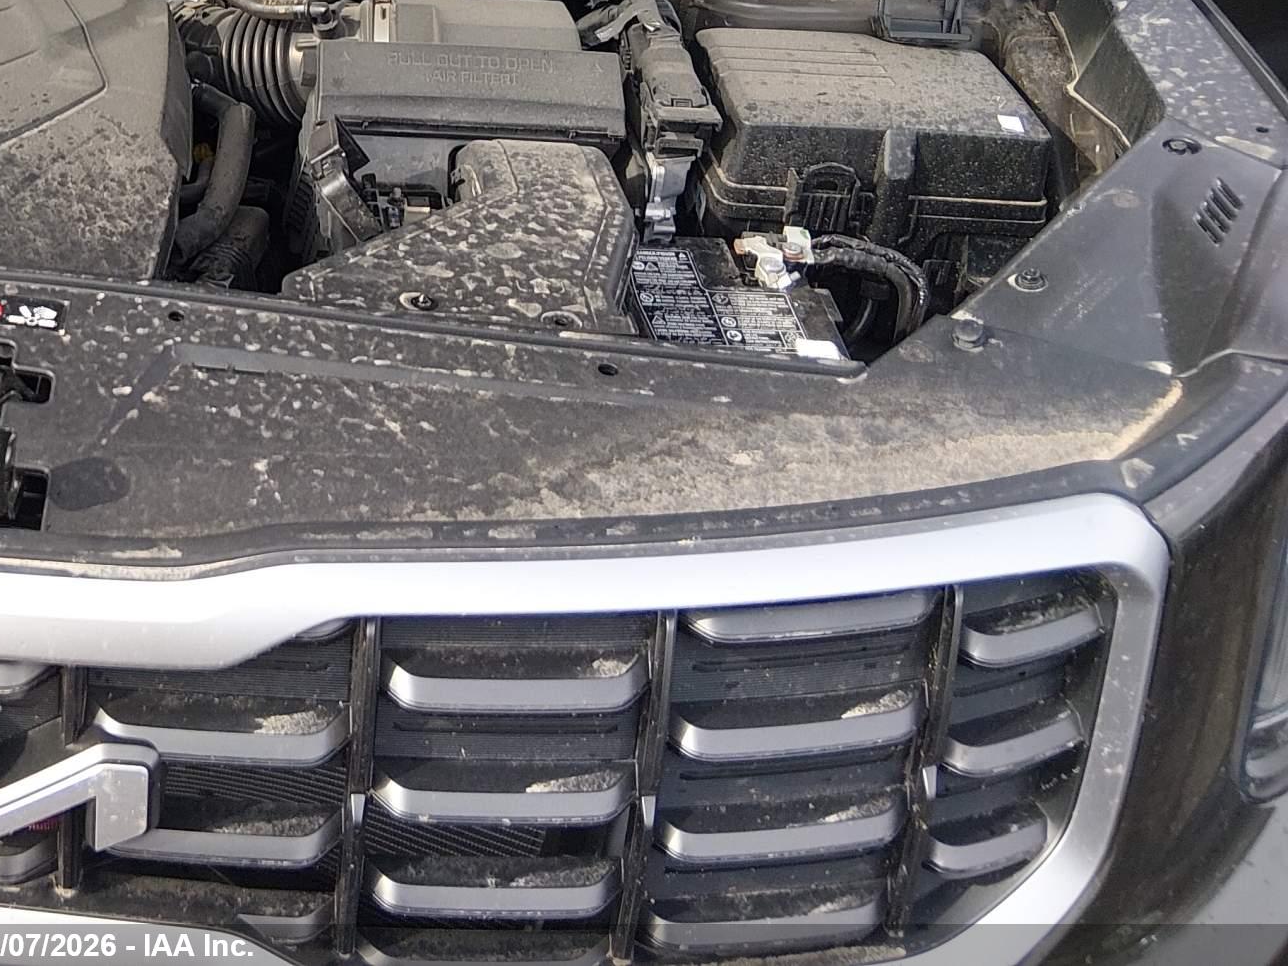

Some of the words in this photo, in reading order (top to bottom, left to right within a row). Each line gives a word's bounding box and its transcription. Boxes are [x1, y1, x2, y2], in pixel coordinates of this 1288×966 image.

[387, 51, 433, 66] PULL
[437, 53, 473, 69] OUT
[476, 55, 501, 70] TO
[505, 56, 554, 74] OPEN
